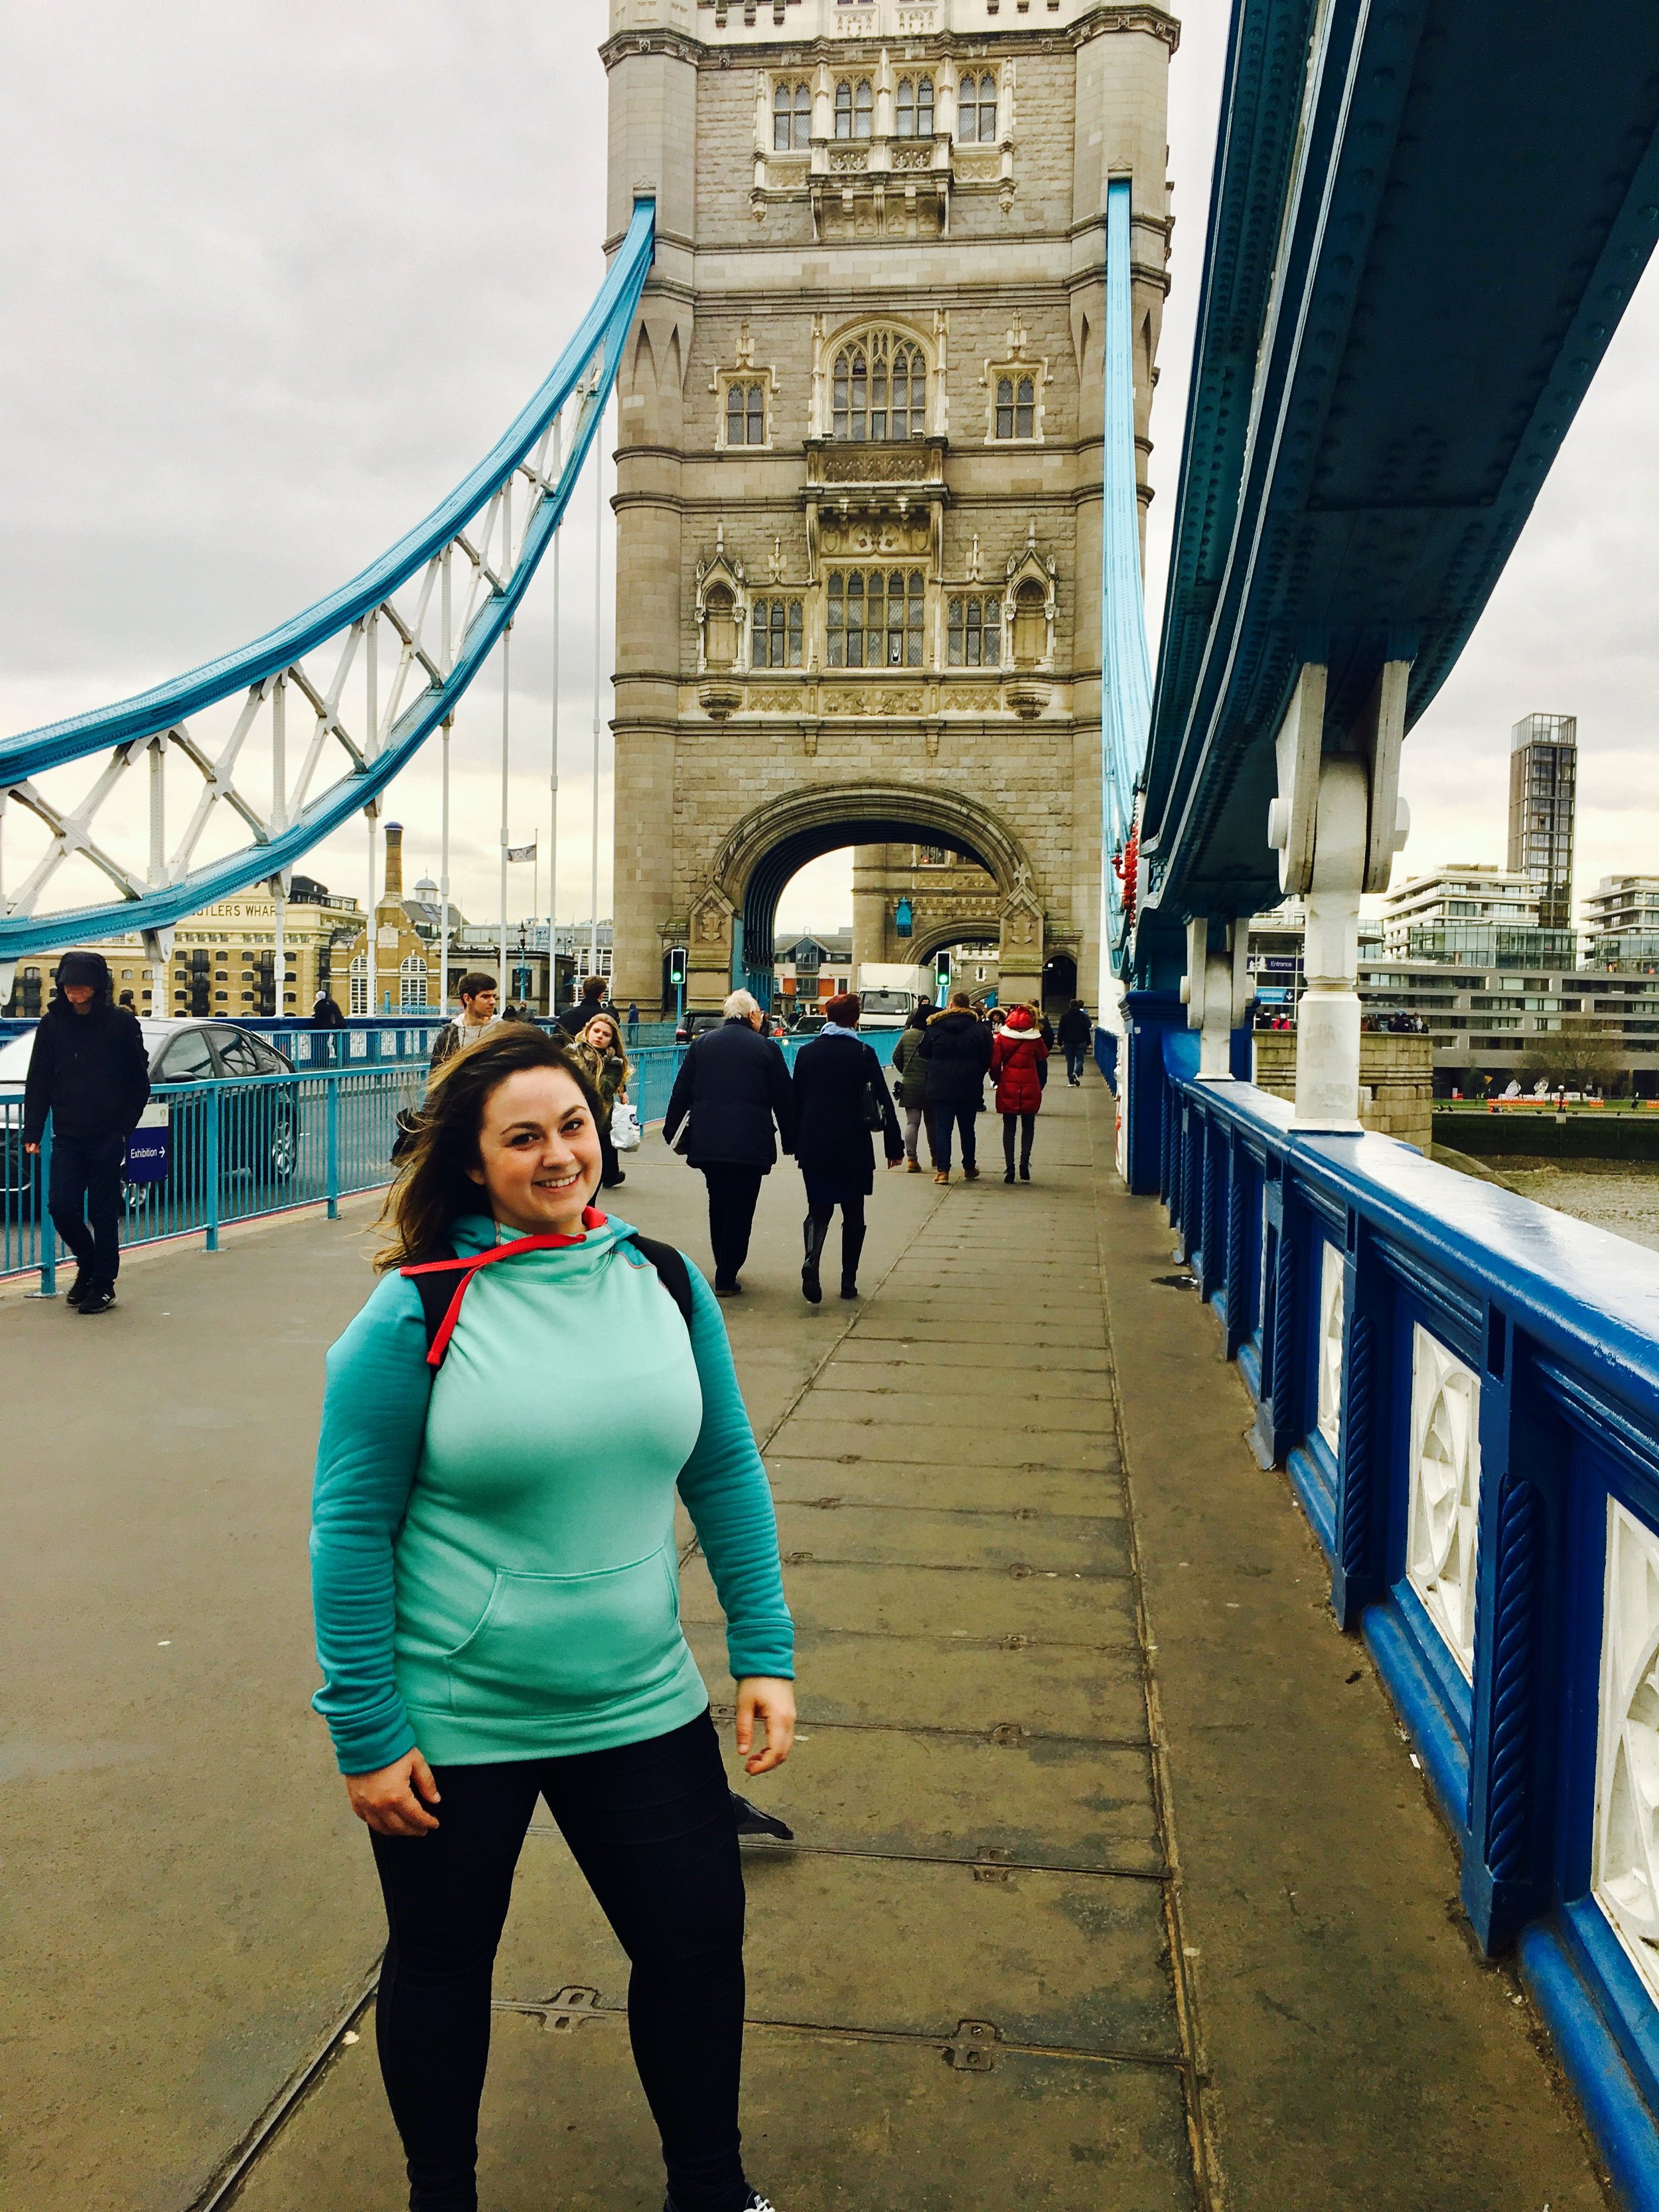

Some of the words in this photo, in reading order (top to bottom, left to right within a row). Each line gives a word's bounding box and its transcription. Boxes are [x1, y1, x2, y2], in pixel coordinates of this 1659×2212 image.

[192, 905, 240, 917] UTLERS
[246, 905, 276, 917] WHAR
[130, 1147, 157, 1159] Exhibition
